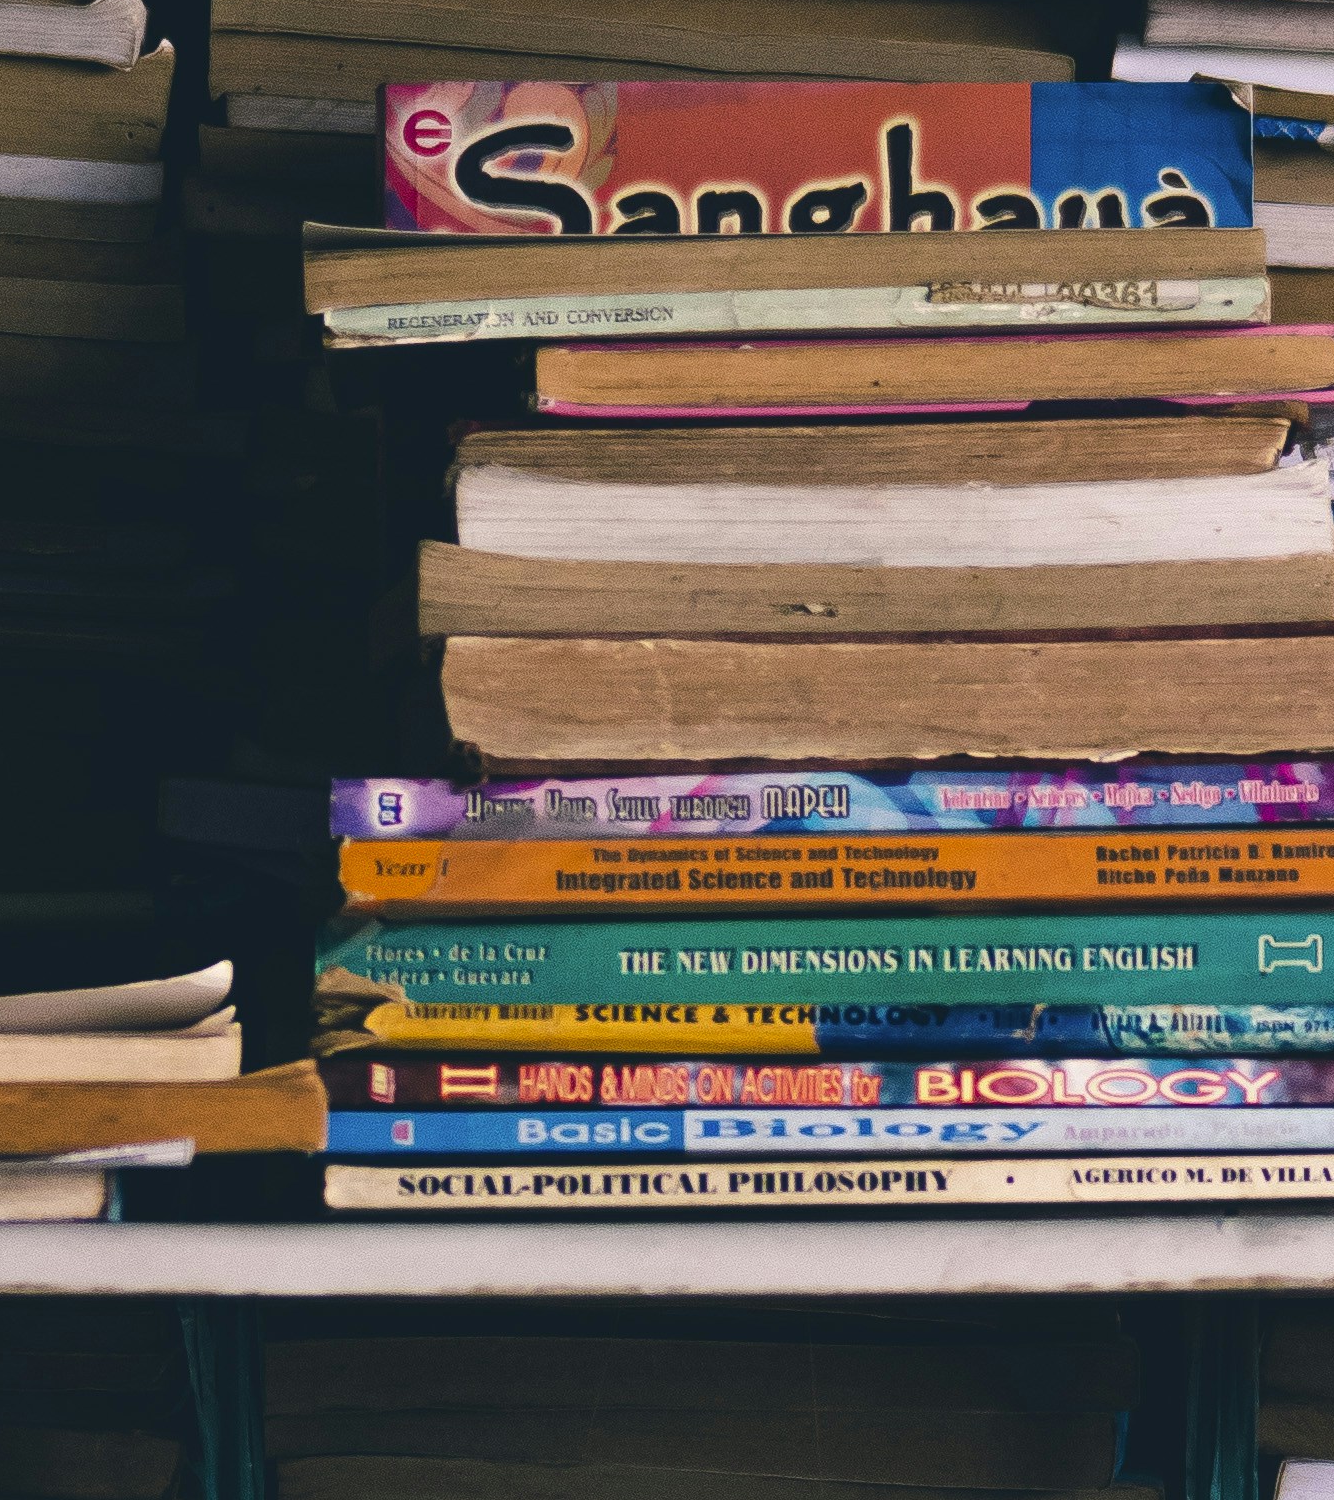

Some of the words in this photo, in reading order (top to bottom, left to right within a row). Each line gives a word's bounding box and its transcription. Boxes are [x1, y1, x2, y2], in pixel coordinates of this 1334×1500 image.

[521, 311, 559, 328] AND
[566, 306, 675, 326] CONVERSION
[761, 784, 850, 820] MAPEH
[592, 847, 623, 863] The
[628, 847, 708, 864] Dynamics
[713, 847, 730, 862] of
[735, 846, 802, 862] Science
[808, 845, 839, 861] and
[844, 844, 940, 863] Technology
[1096, 845, 1160, 863] Rachel
[1167, 845, 1241, 862] Patricia
[374, 858, 429, 878] Year
[1096, 868, 1157, 885] Ritche
[1165, 866, 1211, 885] Peña
[1218, 866, 1300, 884] Manzano
[555, 869, 681, 894] Integrated
[688, 868, 783, 891] Science
[790, 868, 834, 890] and
[841, 866, 978, 892] Technology
[365, 944, 427, 963] Flores
[447, 943, 472, 963] de
[478, 944, 498, 962] la
[503, 942, 547, 963] Cruz
[617, 950, 667, 976] THE
[677, 949, 731, 975] NEW
[740, 949, 899, 974] DIMENSIONS
[907, 949, 936, 973] IN
[942, 947, 1074, 972] LEARNING
[1082, 946, 1196, 971] ENGLISH
[452, 967, 533, 987] Guevara
[574, 1004, 700, 1024] SCIENCE
[711, 1005, 730, 1024] &
[745, 1005, 951, 1028] TECHNOLOGY
[519, 1064, 594, 1103] HANDS
[696, 1064, 735, 1102] ON
[741, 1063, 843, 1102] ACTIVITIES
[852, 1066, 882, 1102] for
[914, 1068, 1281, 1105] BIOLOGY
[517, 1118, 672, 1146] Basic
[695, 1116, 1048, 1145] Biology
[397, 1171, 719, 1197] SOCIAL-POLITICAL
[728, 1168, 952, 1194] PHILOSOPHY
[1071, 1169, 1178, 1185] AGERICO
[1186, 1168, 1213, 1184] M.
[1221, 1168, 1253, 1183] DE
